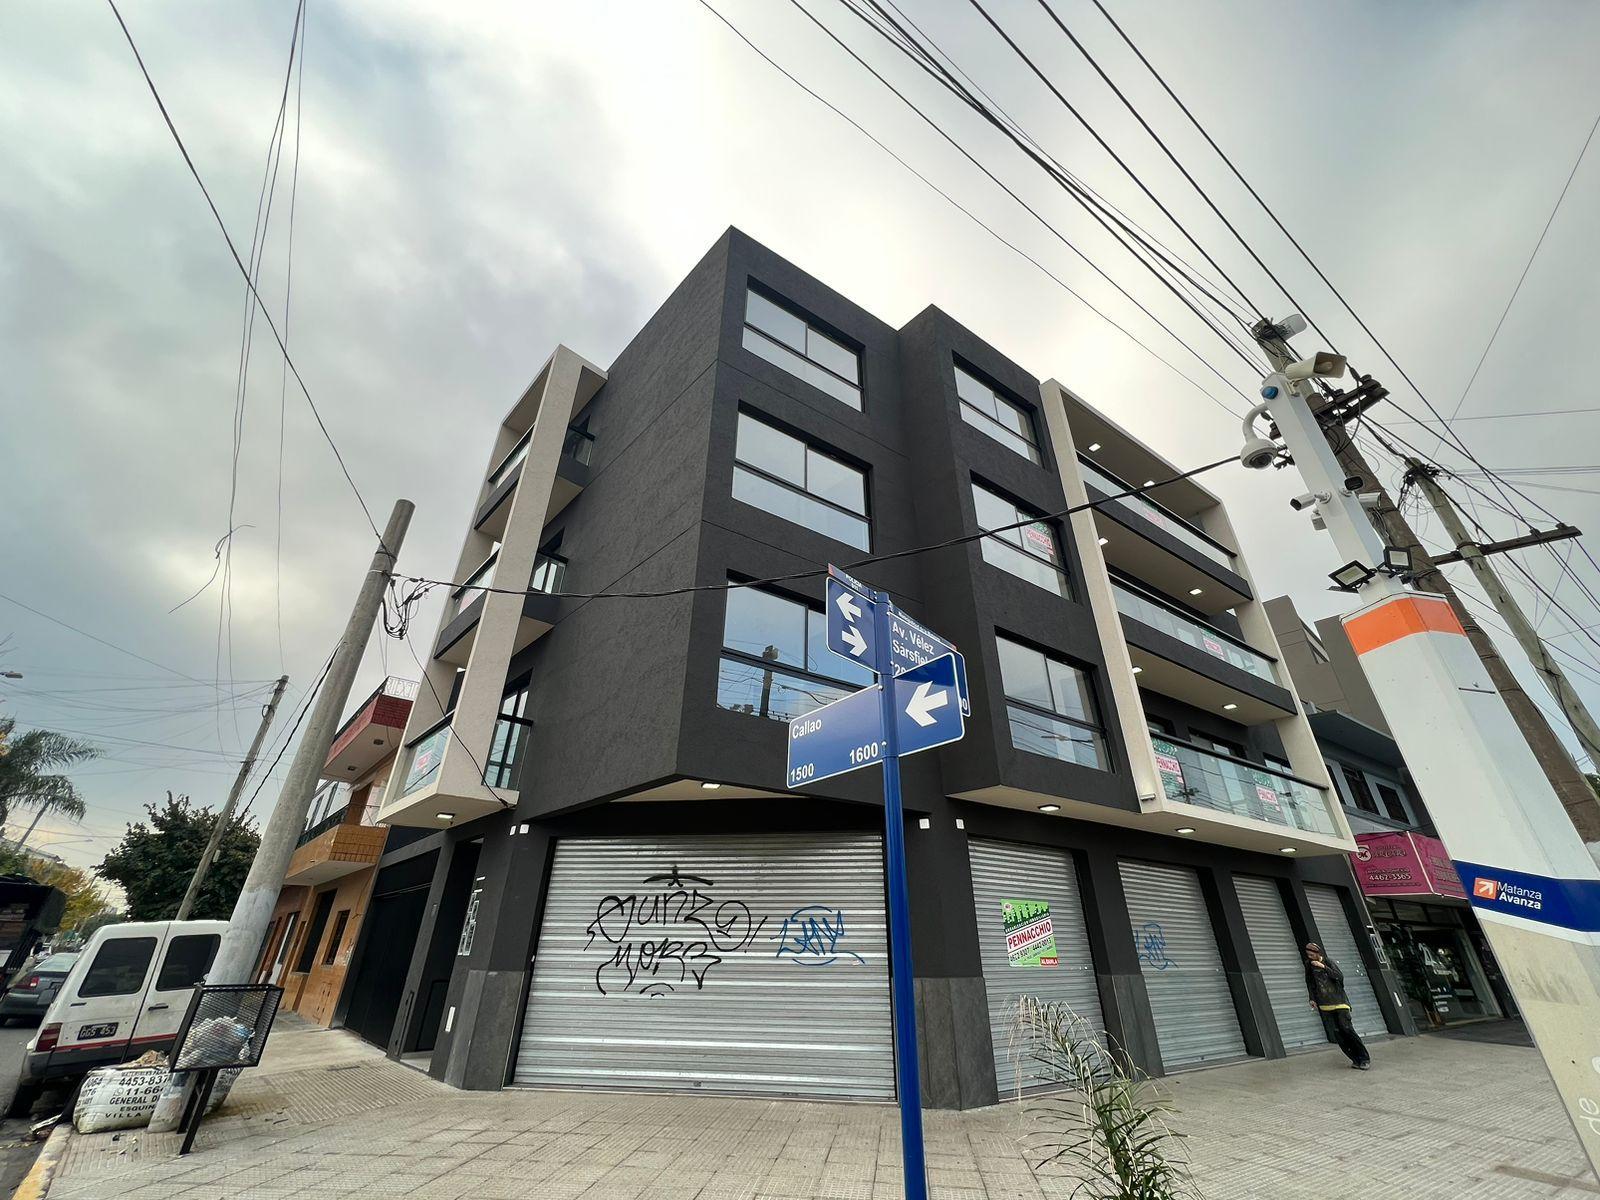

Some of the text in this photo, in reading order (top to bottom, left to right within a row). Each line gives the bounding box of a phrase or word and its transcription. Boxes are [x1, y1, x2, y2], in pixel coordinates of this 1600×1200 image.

[892, 621, 908, 640] Av.
[909, 630, 935, 655] Vélez
[893, 639, 929, 665] Sársfiel
[792, 719, 822, 739] Callao
[849, 742, 879, 764] 1600
[790, 763, 815, 782] 1500
[1369, 873, 1412, 881] 4462-3365
[1497, 881, 1542, 900] Matanza
[1499, 891, 1542, 910] Avanza
[1007, 921, 1052, 949] PENNACCHIO
[119, 1075, 169, 1086] 4453-837
[109, 1096, 147, 1105] GENERAL
